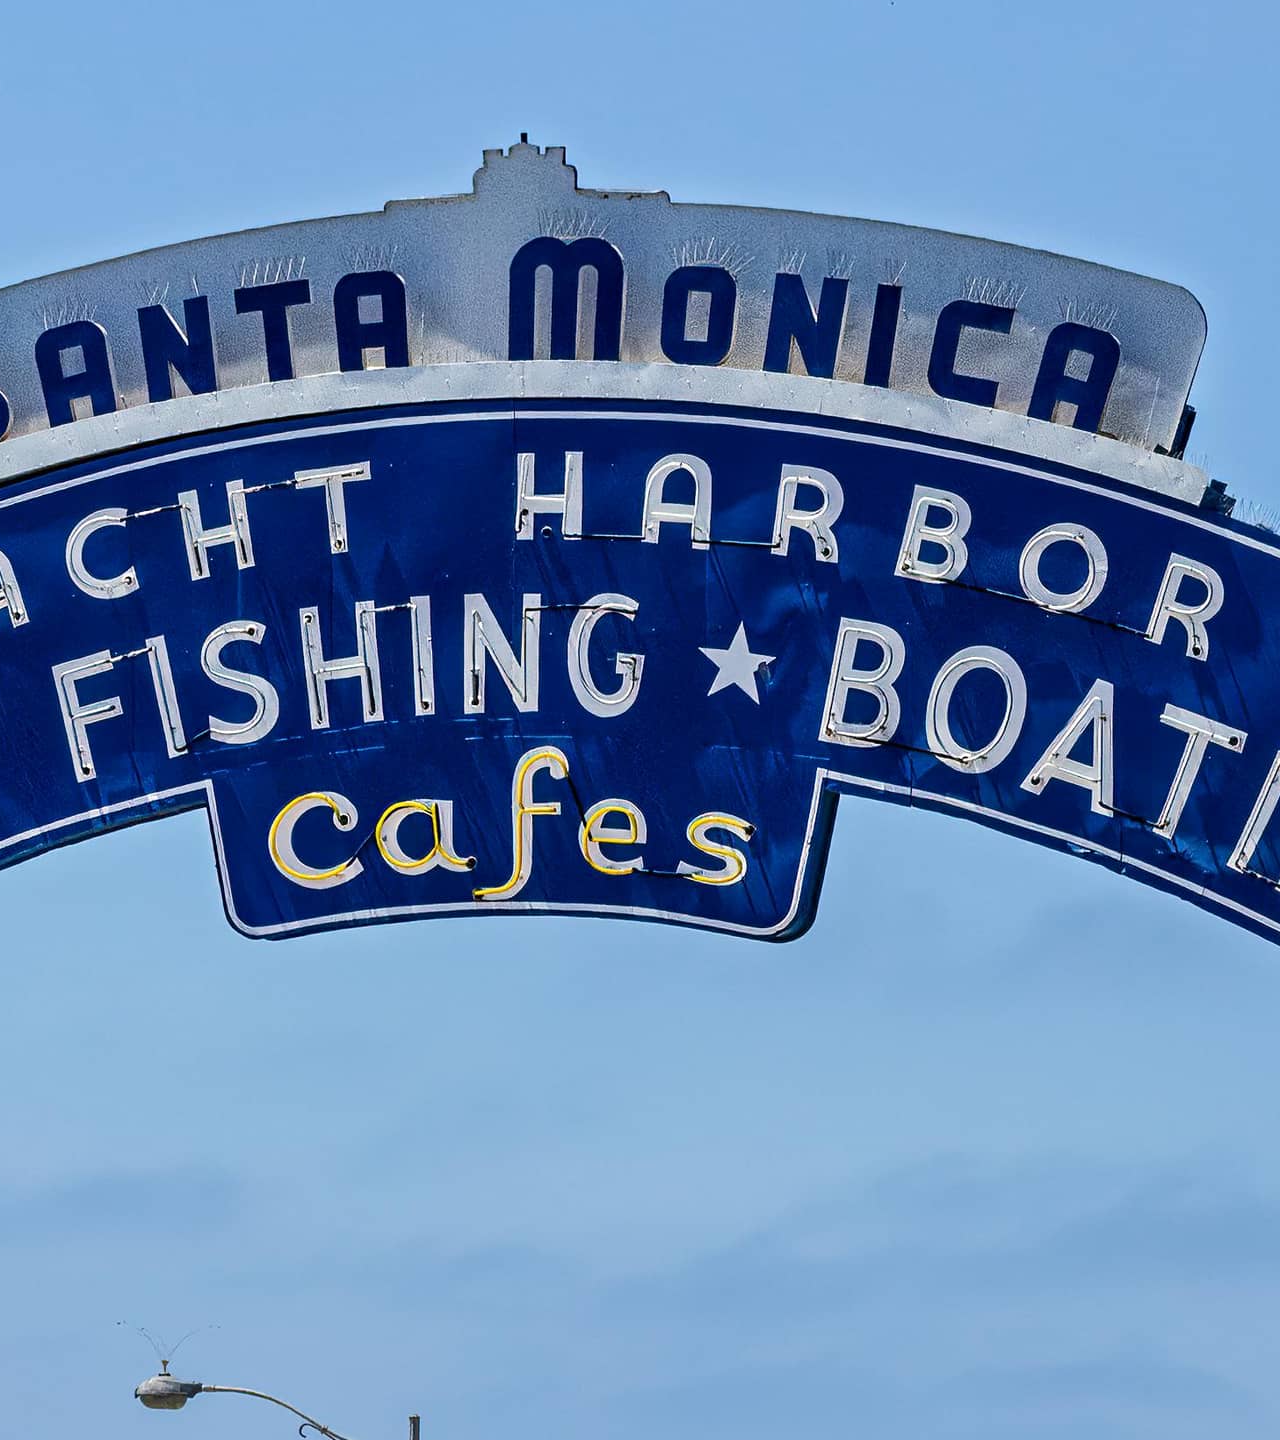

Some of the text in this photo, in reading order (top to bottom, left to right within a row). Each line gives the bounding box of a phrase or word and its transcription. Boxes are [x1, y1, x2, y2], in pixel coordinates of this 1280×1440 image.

[509, 235, 1122, 434] MONICA
[515, 450, 1227, 662] HARBOR
[51, 592, 646, 783] FISHING
